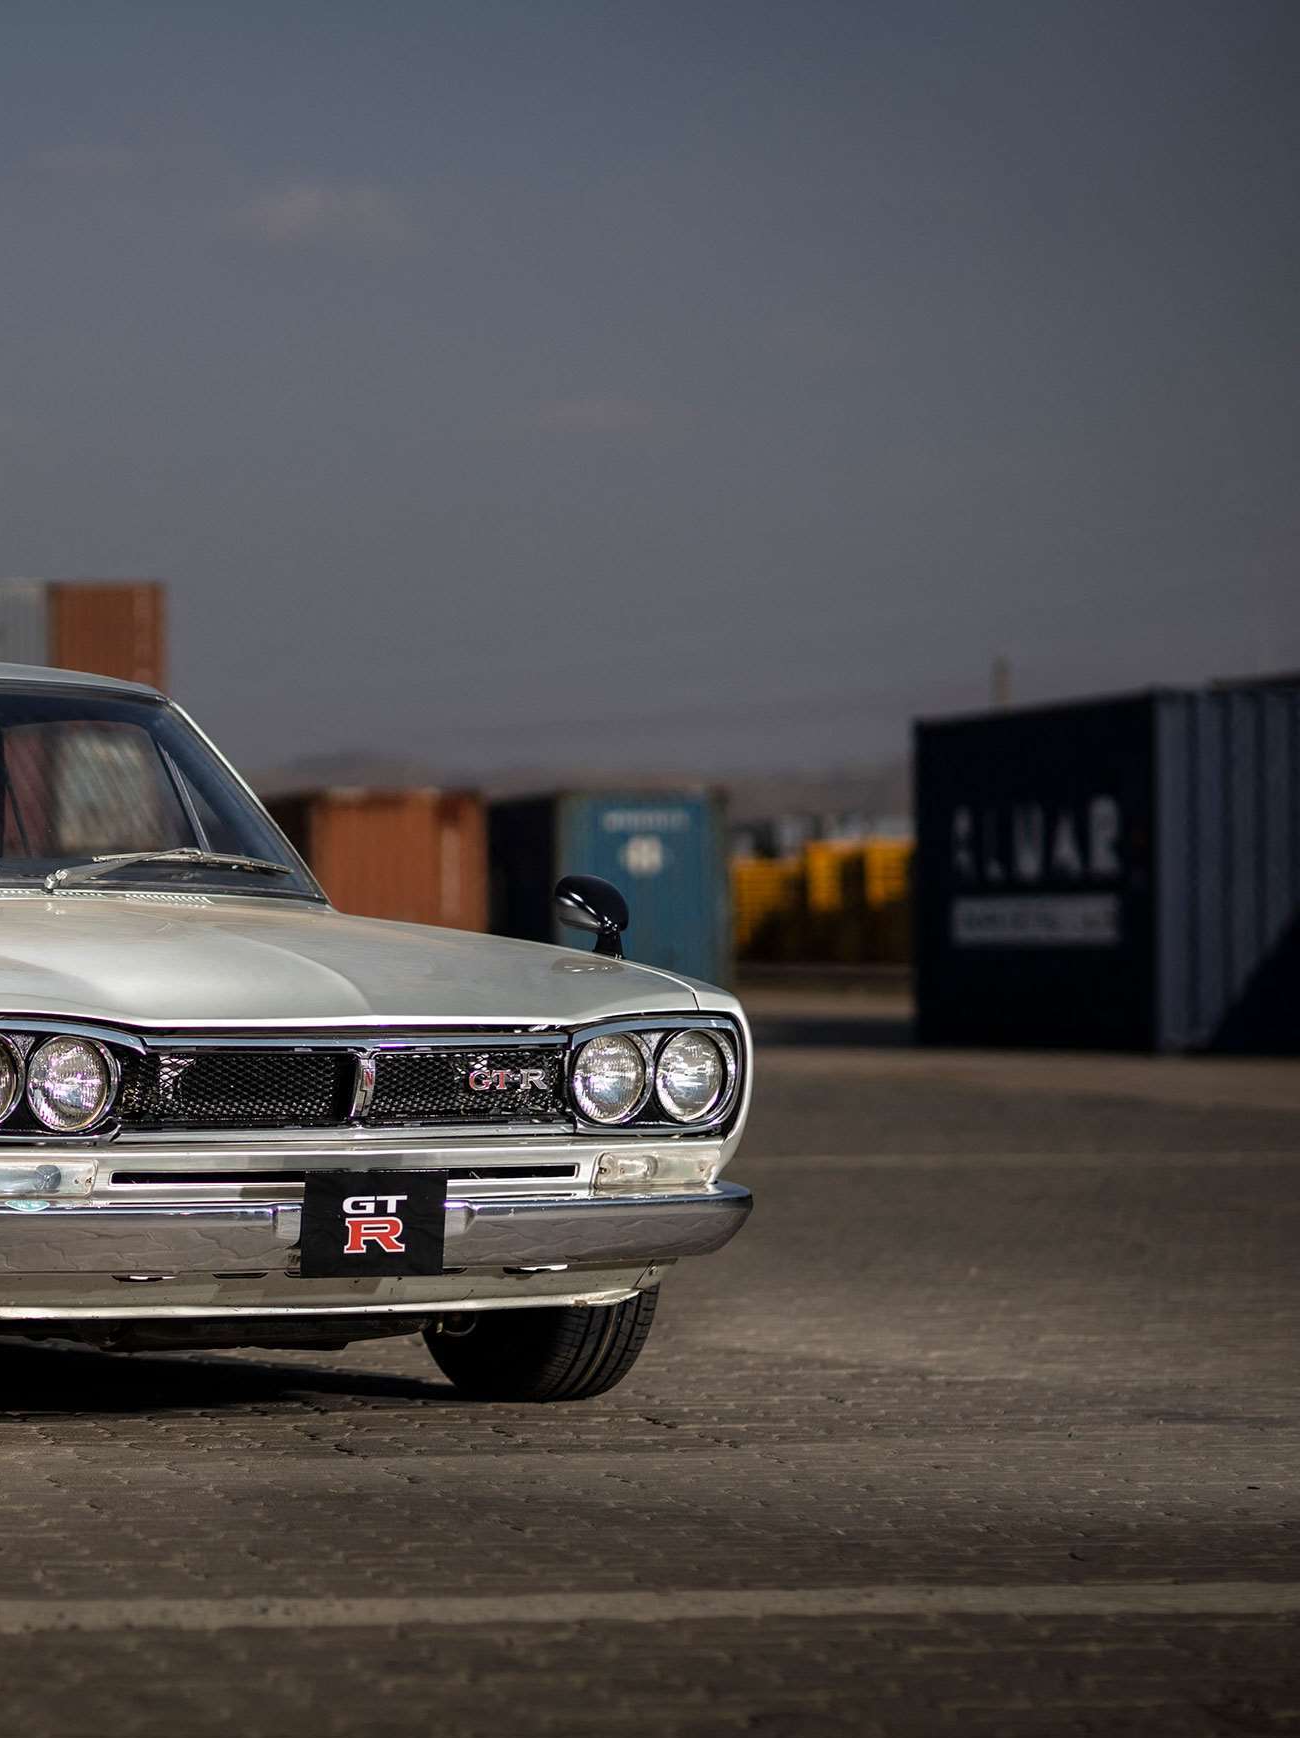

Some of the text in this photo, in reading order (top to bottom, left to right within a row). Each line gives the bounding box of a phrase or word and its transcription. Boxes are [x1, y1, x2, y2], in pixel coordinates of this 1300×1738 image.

[468, 1068, 548, 1091] GT-R
[342, 1195, 408, 1214] GT
[343, 1216, 406, 1255] R
